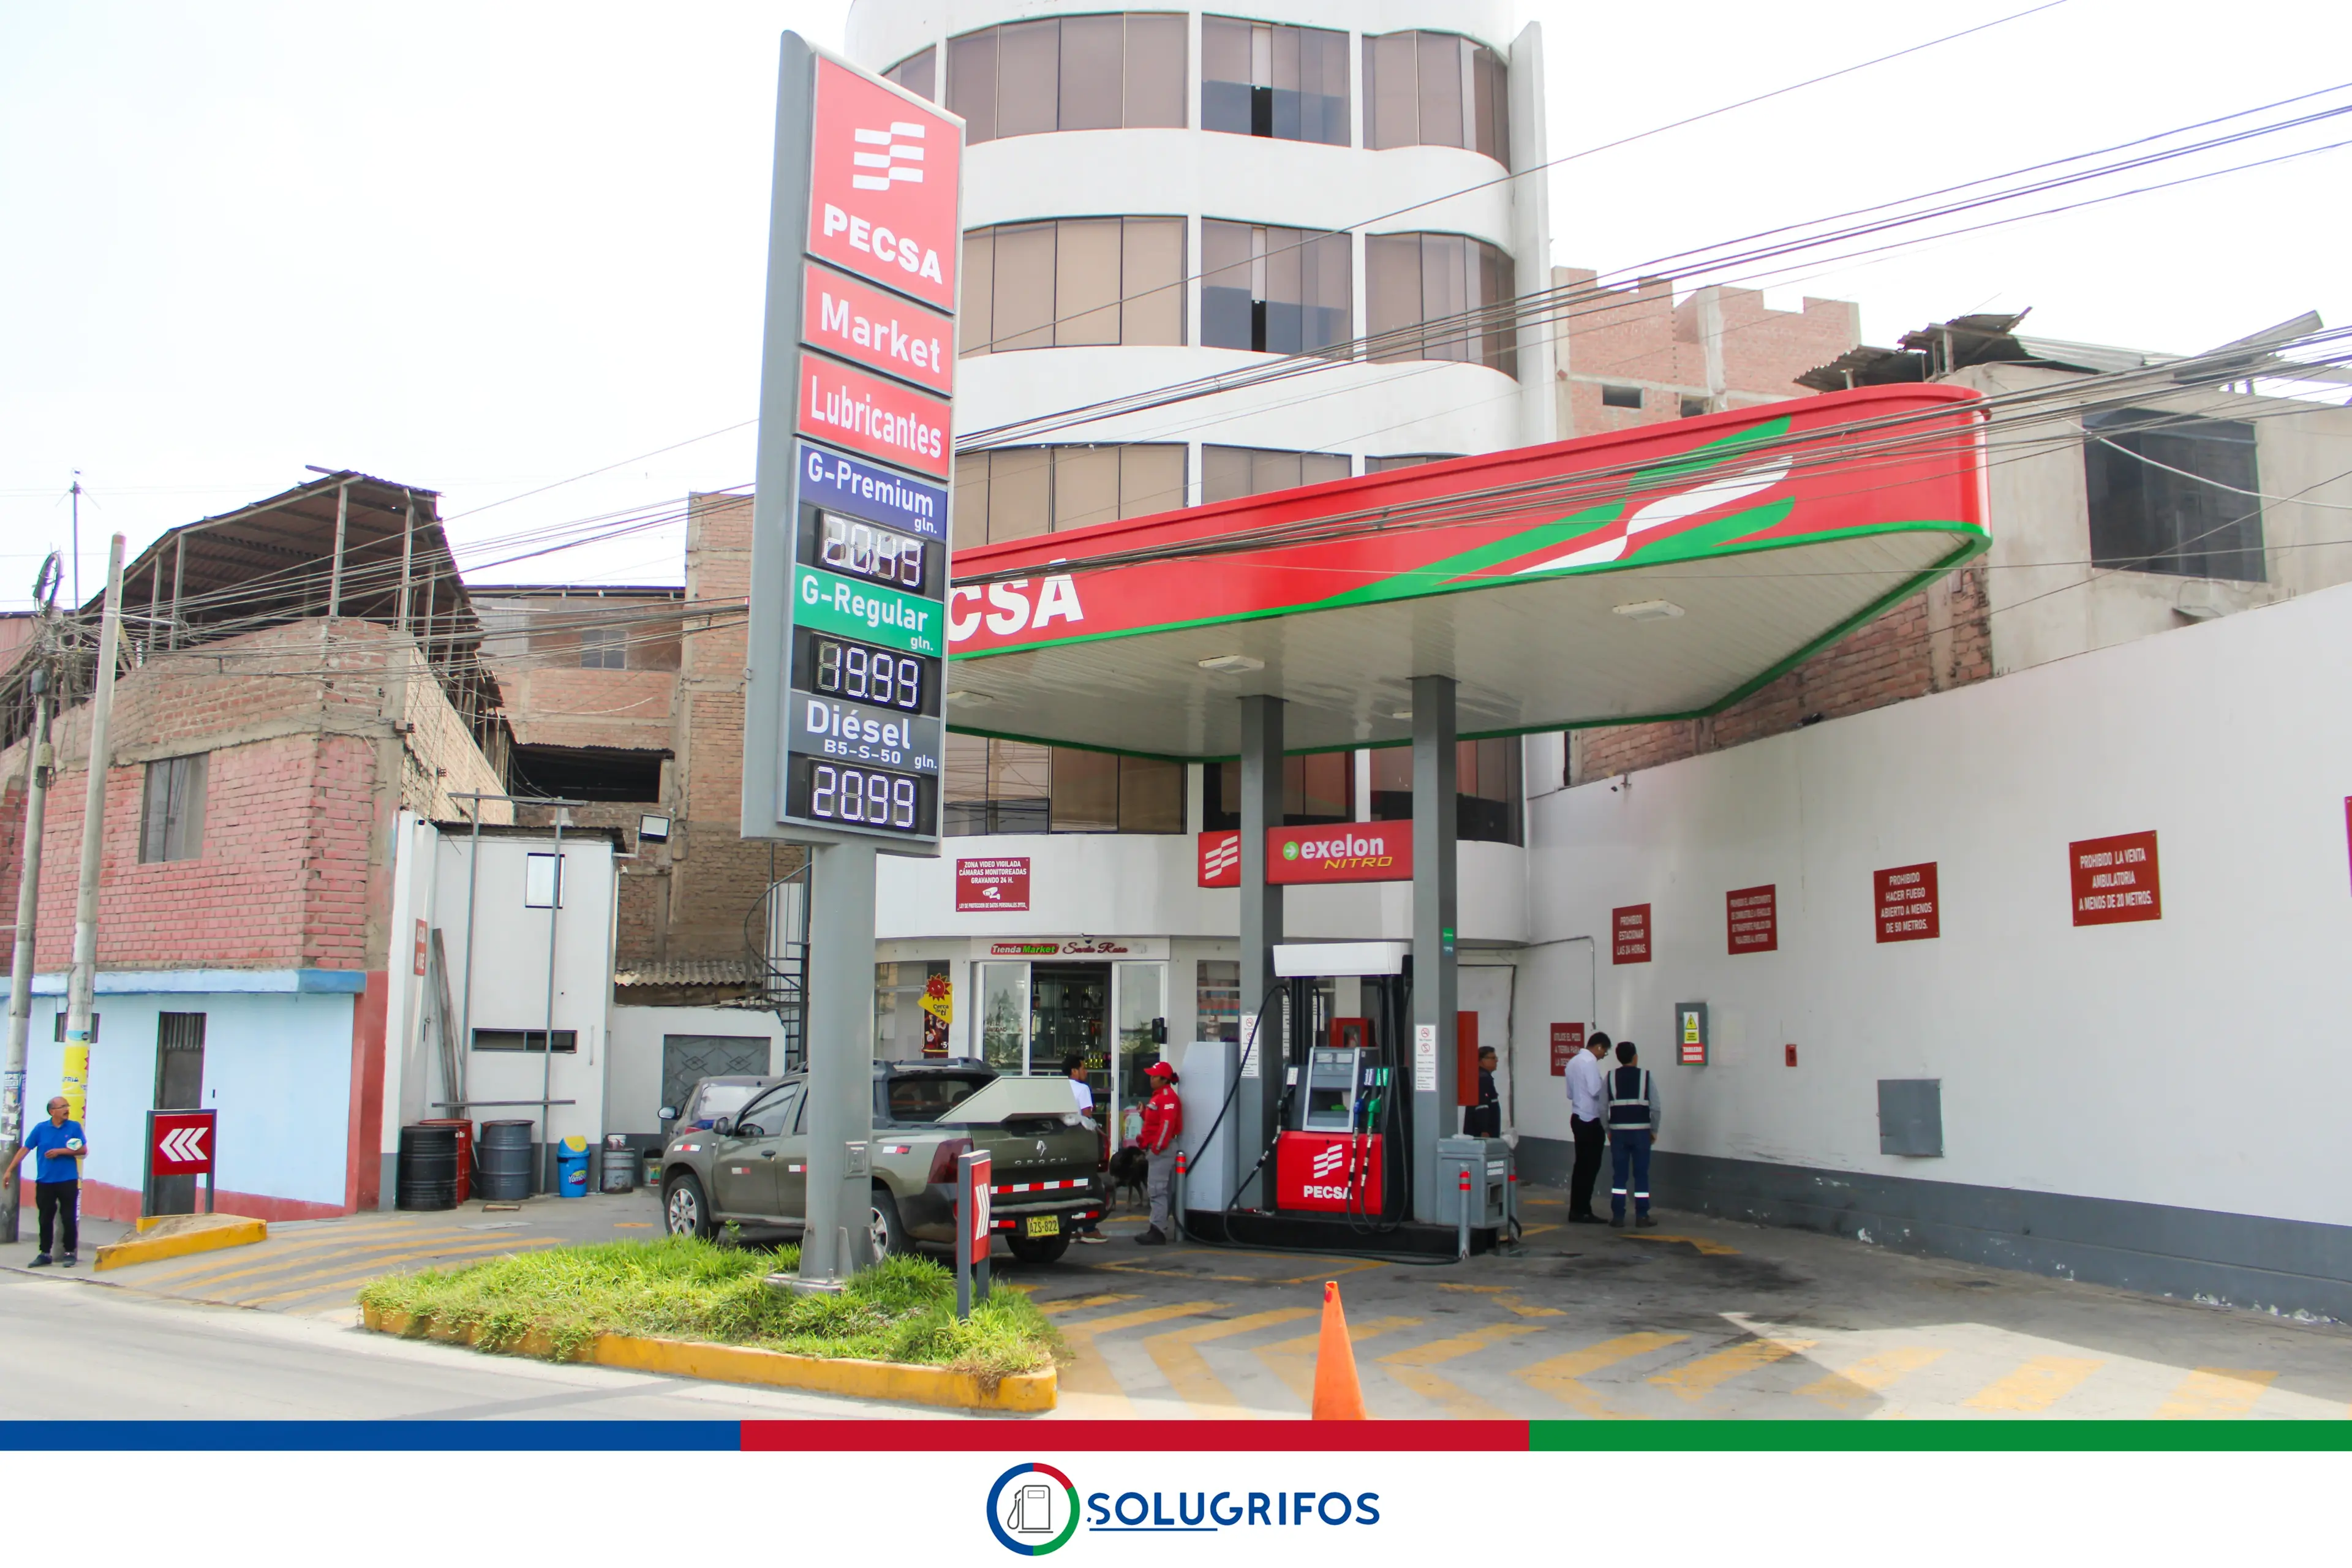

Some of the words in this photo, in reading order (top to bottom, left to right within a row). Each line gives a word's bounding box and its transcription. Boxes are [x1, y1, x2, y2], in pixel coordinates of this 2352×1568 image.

[823, 202, 943, 285] PECSA
[821, 292, 940, 374] Market
[811, 375, 941, 459] Lubricantes
[808, 451, 933, 518] G-Premium
[914, 518, 937, 534] gln.
[823, 516, 921, 587] 20.49
[802, 575, 929, 632] G-Regular
[910, 636, 934, 652] gln.
[828, 644, 919, 708] 19.99
[807, 699, 911, 750] Diésel
[824, 739, 901, 764] B5-S-50
[914, 755, 938, 770] gln.
[813, 766, 914, 827] 20.99
[1301, 834, 1384, 859] exelon
[1324, 856, 1393, 870] NITRO
[2079, 852, 2113, 869] PROHIBIDO
[2115, 850, 2124, 864] LA
[2125, 848, 2146, 863] VENTA
[1889, 872, 1920, 886] PROHIBIDO
[2092, 870, 2136, 888] AMBULATORIA
[1885, 890, 1905, 902] HACER
[1906, 887, 1926, 899] FUEGO
[2079, 898, 2084, 911] A
[2085, 895, 2106, 910] MENOS
[2107, 894, 2116, 908] DE
[2117, 894, 2124, 907] 20
[2125, 891, 2154, 906] METROS.
[1880, 906, 1904, 918] ABIERTO
[1905, 905, 1910, 915] A
[1911, 902, 1932, 914] MENOS
[1620, 914, 1642, 926] PROHIBIDO
[1886, 922, 1894, 933] DE
[1895, 922, 1902, 932] 50
[1903, 919, 1928, 931] METROS.
[1619, 929, 1644, 941] ESTACIONAR
[992, 944, 1022, 954] Tienda
[1022, 944, 1056, 954] Market
[1303, 1185, 1353, 1200] PECSA
[1030, 1220, 1058, 1234] AZS-822
